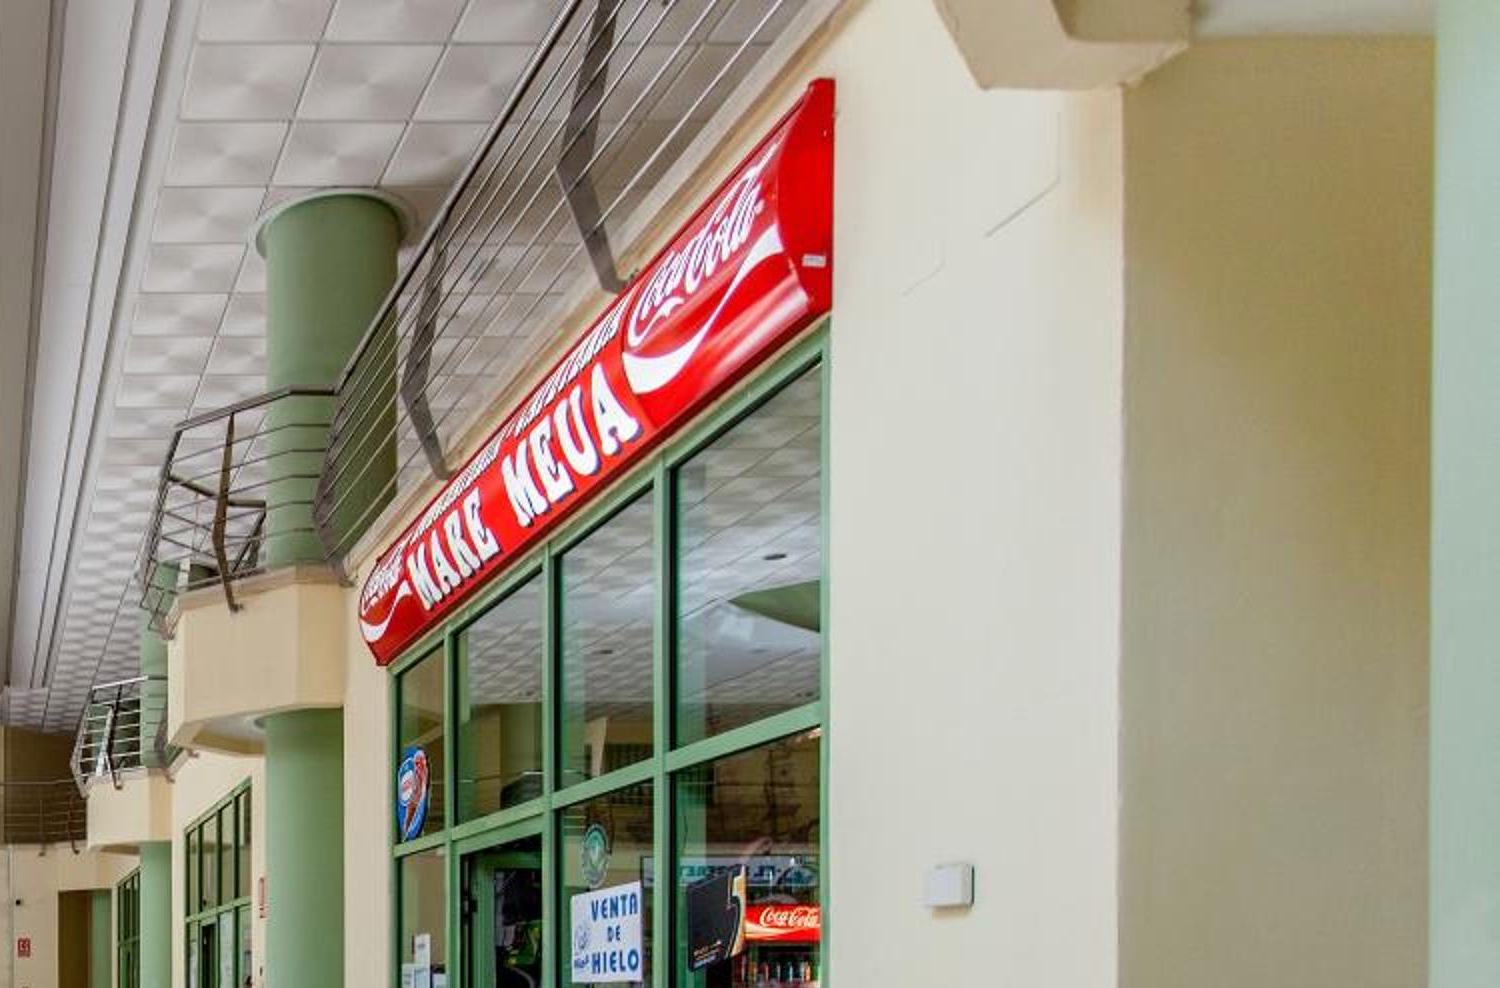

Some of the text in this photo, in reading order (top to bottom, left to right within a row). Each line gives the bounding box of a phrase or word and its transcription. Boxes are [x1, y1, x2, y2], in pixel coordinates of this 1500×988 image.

[407, 486, 501, 612] MARE
[501, 361, 644, 528] MEUA
[591, 892, 639, 921] VENTA
[607, 925, 621, 942] DE
[591, 948, 639, 974] HIELO
